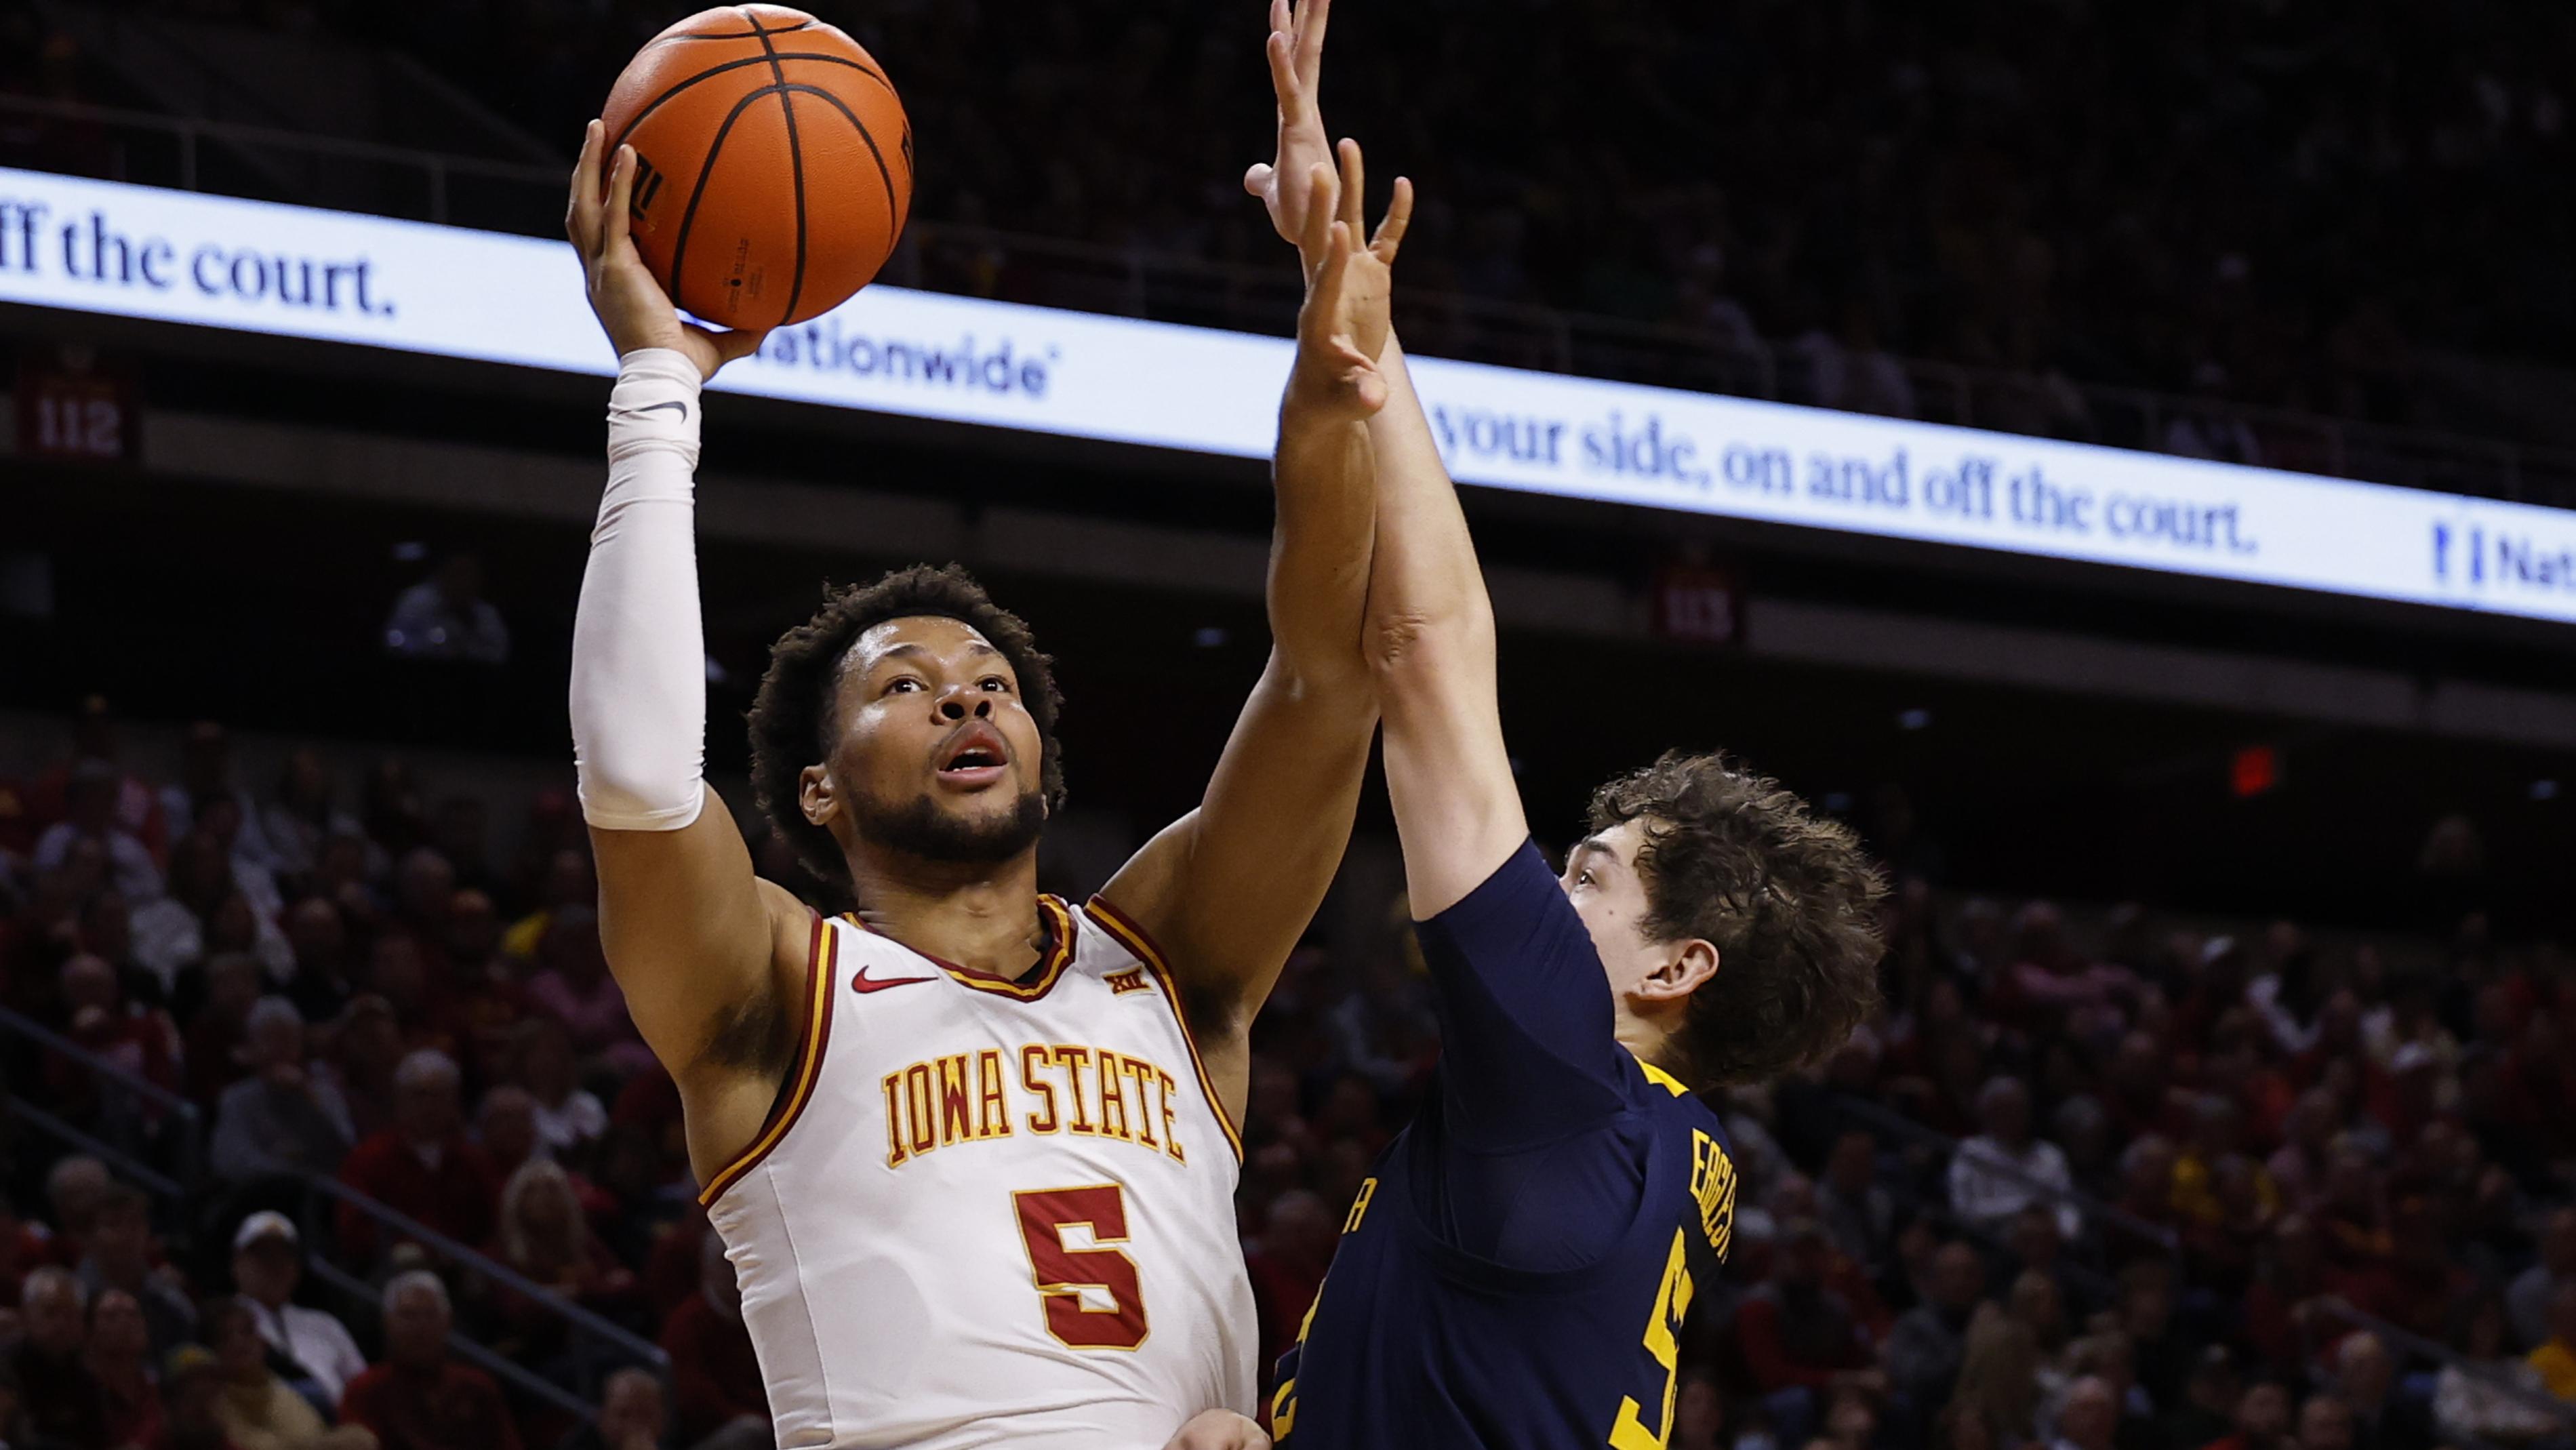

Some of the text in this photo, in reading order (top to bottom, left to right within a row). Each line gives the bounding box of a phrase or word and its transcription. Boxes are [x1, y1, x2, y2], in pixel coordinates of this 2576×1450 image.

[0, 199, 397, 316] ff the court.
[756, 319, 1047, 397] ationwide
[39, 398, 125, 455] 112
[1582, 408, 1711, 489] side,
[1722, 442, 1794, 495] on
[1807, 444, 1910, 510] and
[1924, 454, 1998, 519] off
[2010, 465, 2093, 531] the
[2106, 489, 2259, 555] court.
[881, 1042, 1188, 1169] IOWA STATE
[1011, 1184, 1150, 1352] 5
